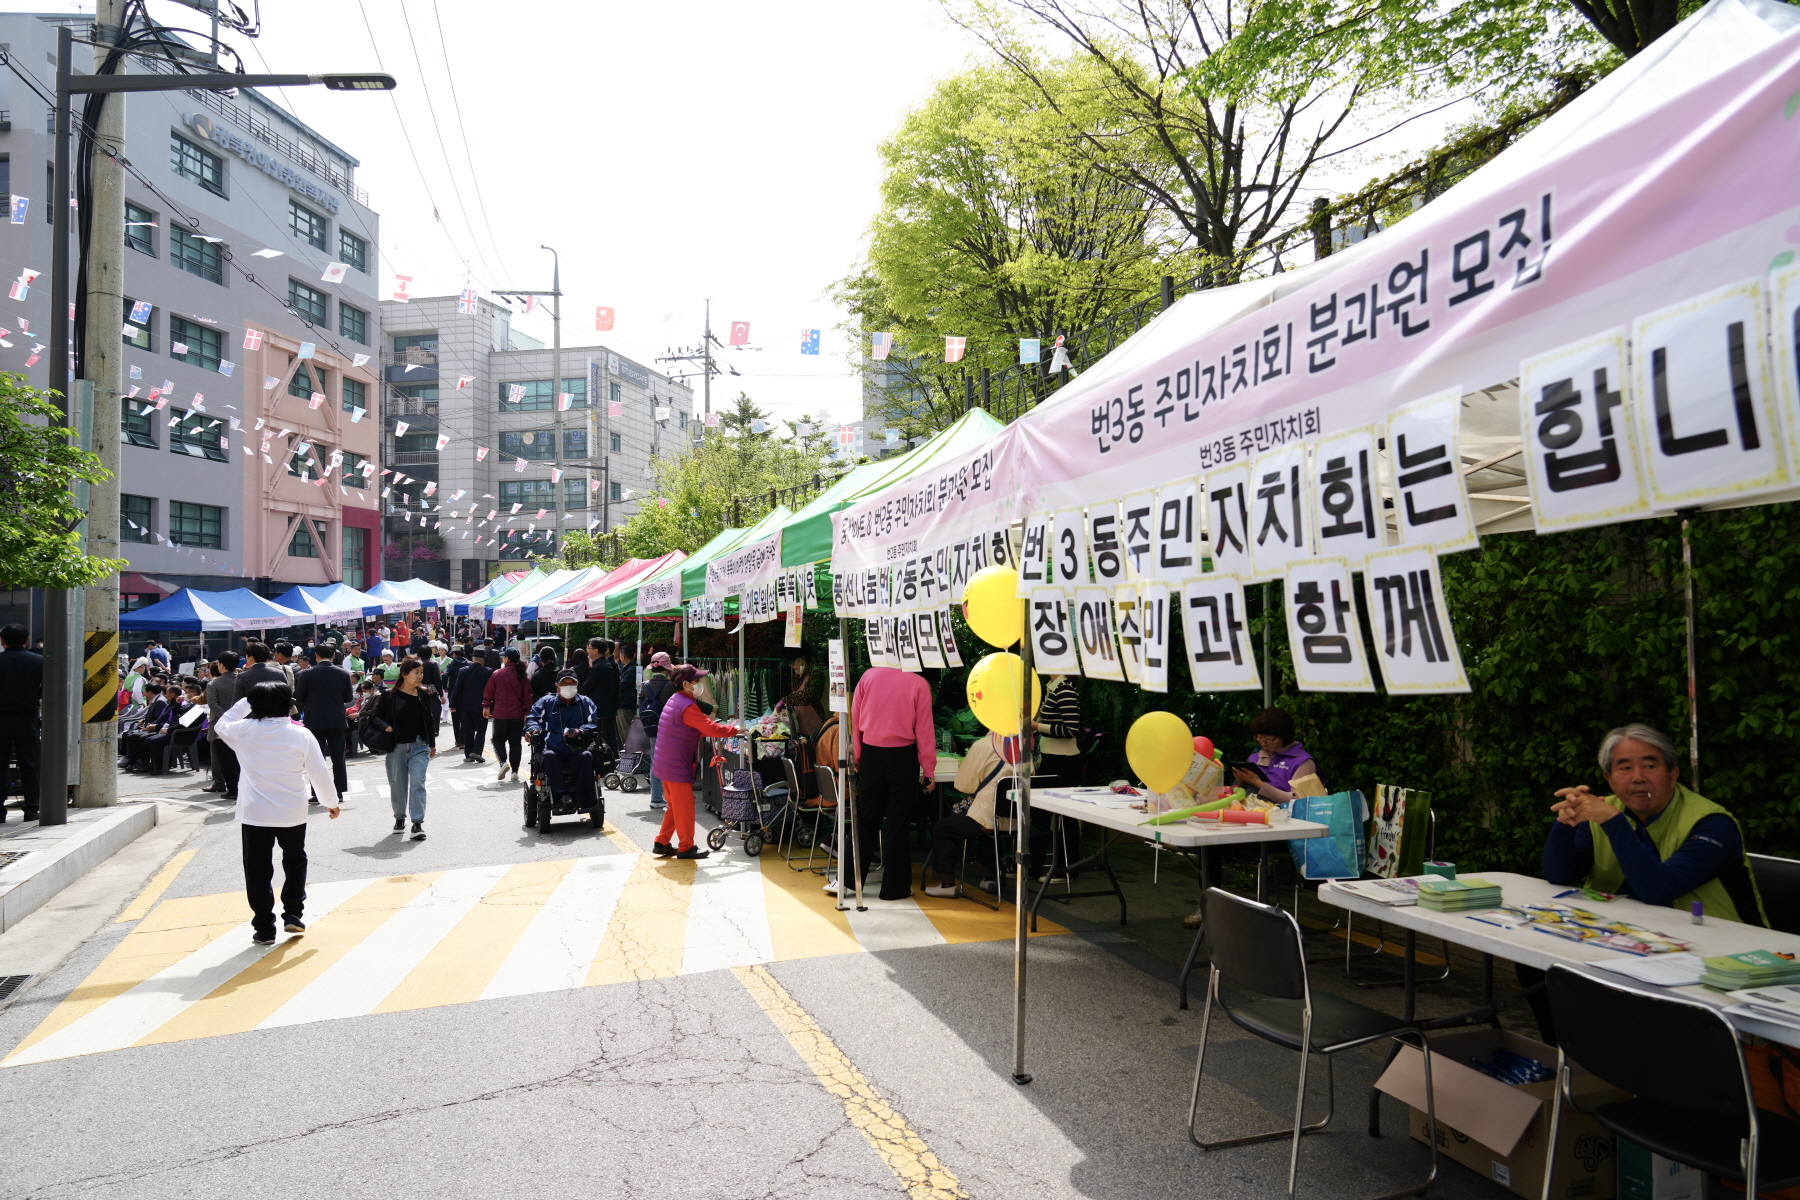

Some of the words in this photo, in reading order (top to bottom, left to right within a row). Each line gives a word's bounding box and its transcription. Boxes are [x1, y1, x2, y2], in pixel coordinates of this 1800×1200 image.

[215, 125, 340, 214] 강북장애인종합복지관
[1091, 383, 1146, 454] 번3동
[1153, 322, 1294, 429] 주민자치회
[1305, 248, 1431, 375] 분과원
[1448, 193, 1554, 308] 모집
[1199, 434, 1237, 471] 번3동
[1239, 406, 1322, 458] 주민자치회
[1534, 302, 1800, 494] 합니
[866, 510, 873, 536] &
[874, 500, 893, 537] 번2동
[894, 483, 936, 529] 주민자치회
[938, 461, 970, 513] 분과원
[970, 448, 994, 492] 모집
[1294, 569, 1450, 665] 함께
